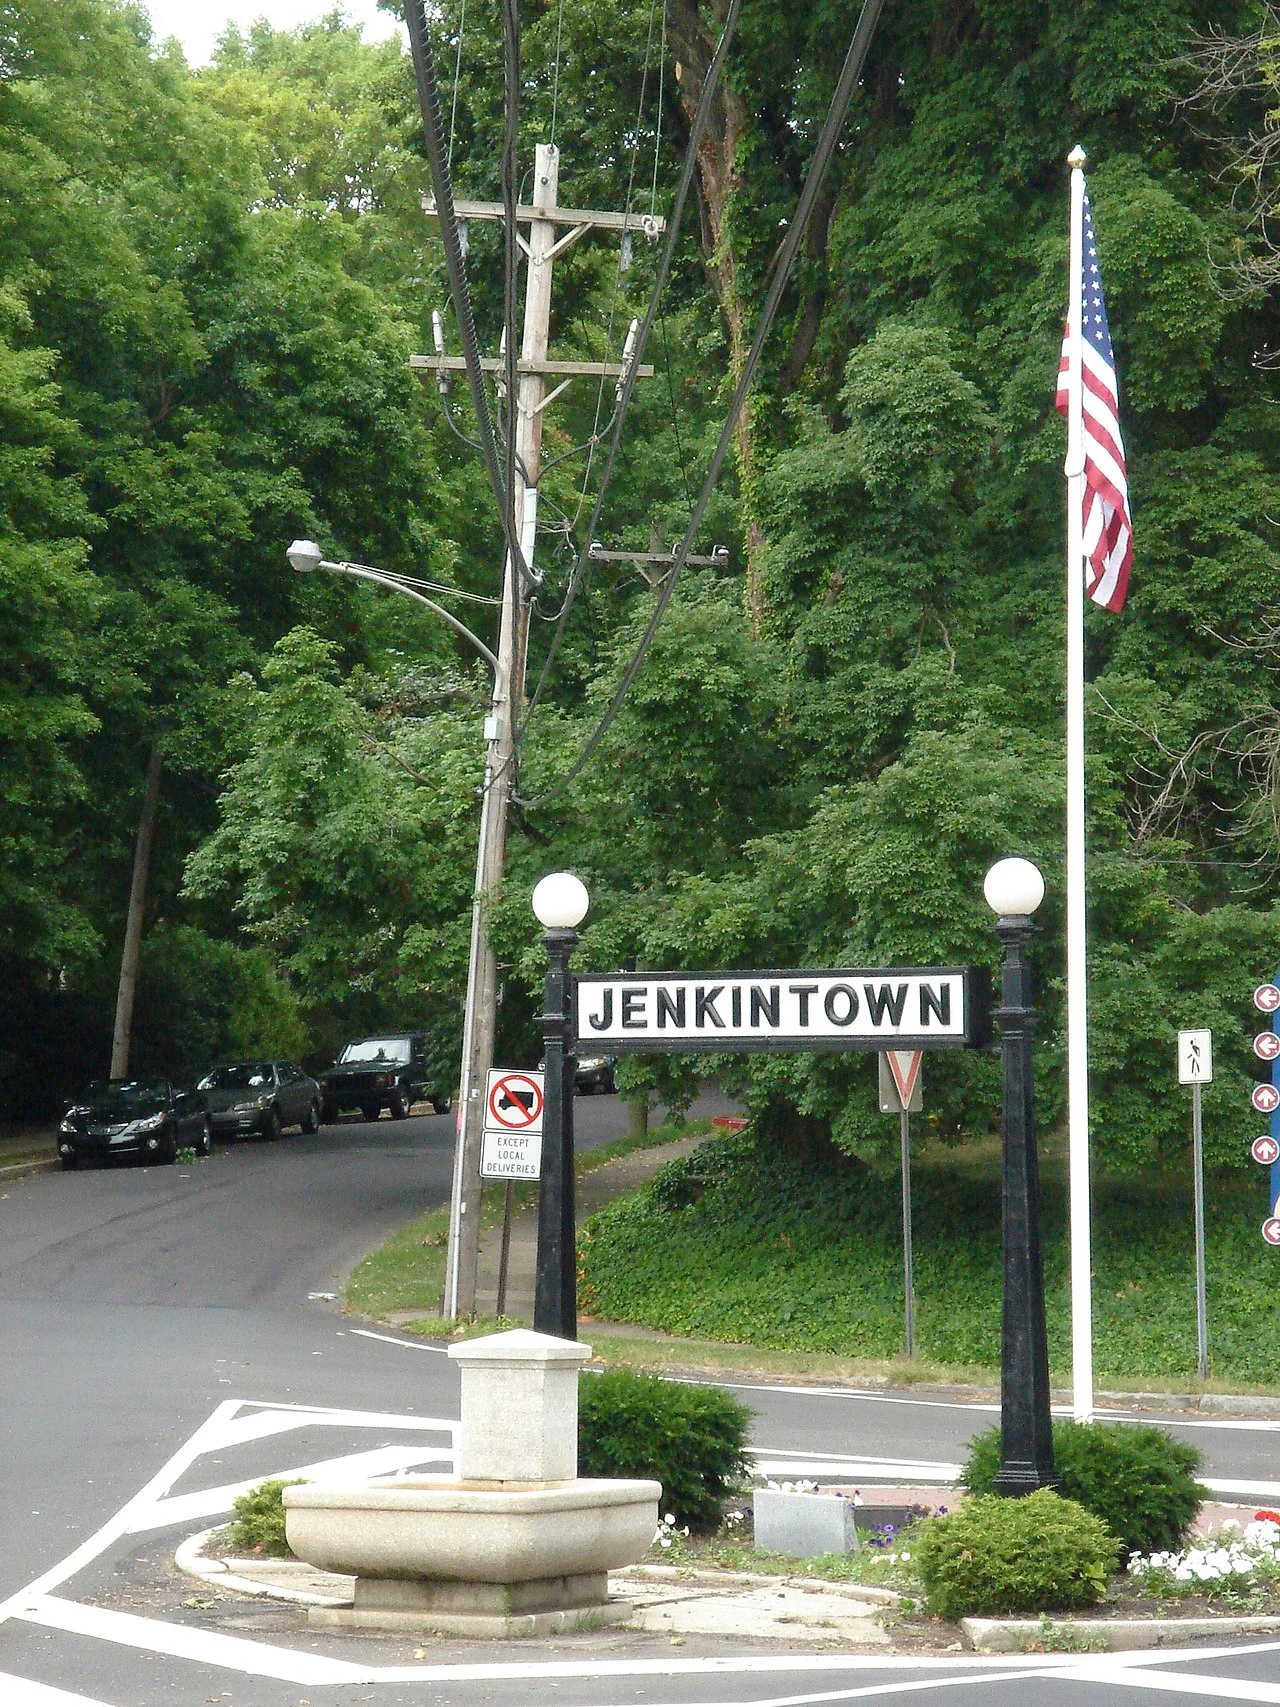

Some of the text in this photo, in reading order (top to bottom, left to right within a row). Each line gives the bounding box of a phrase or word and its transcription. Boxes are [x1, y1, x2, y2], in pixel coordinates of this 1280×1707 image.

[589, 983, 951, 1031] JENKINTOWN
[497, 1137, 529, 1148] EXCEPT
[498, 1150, 525, 1161] LOCAL
[486, 1162, 536, 1174] DELIVERIES
